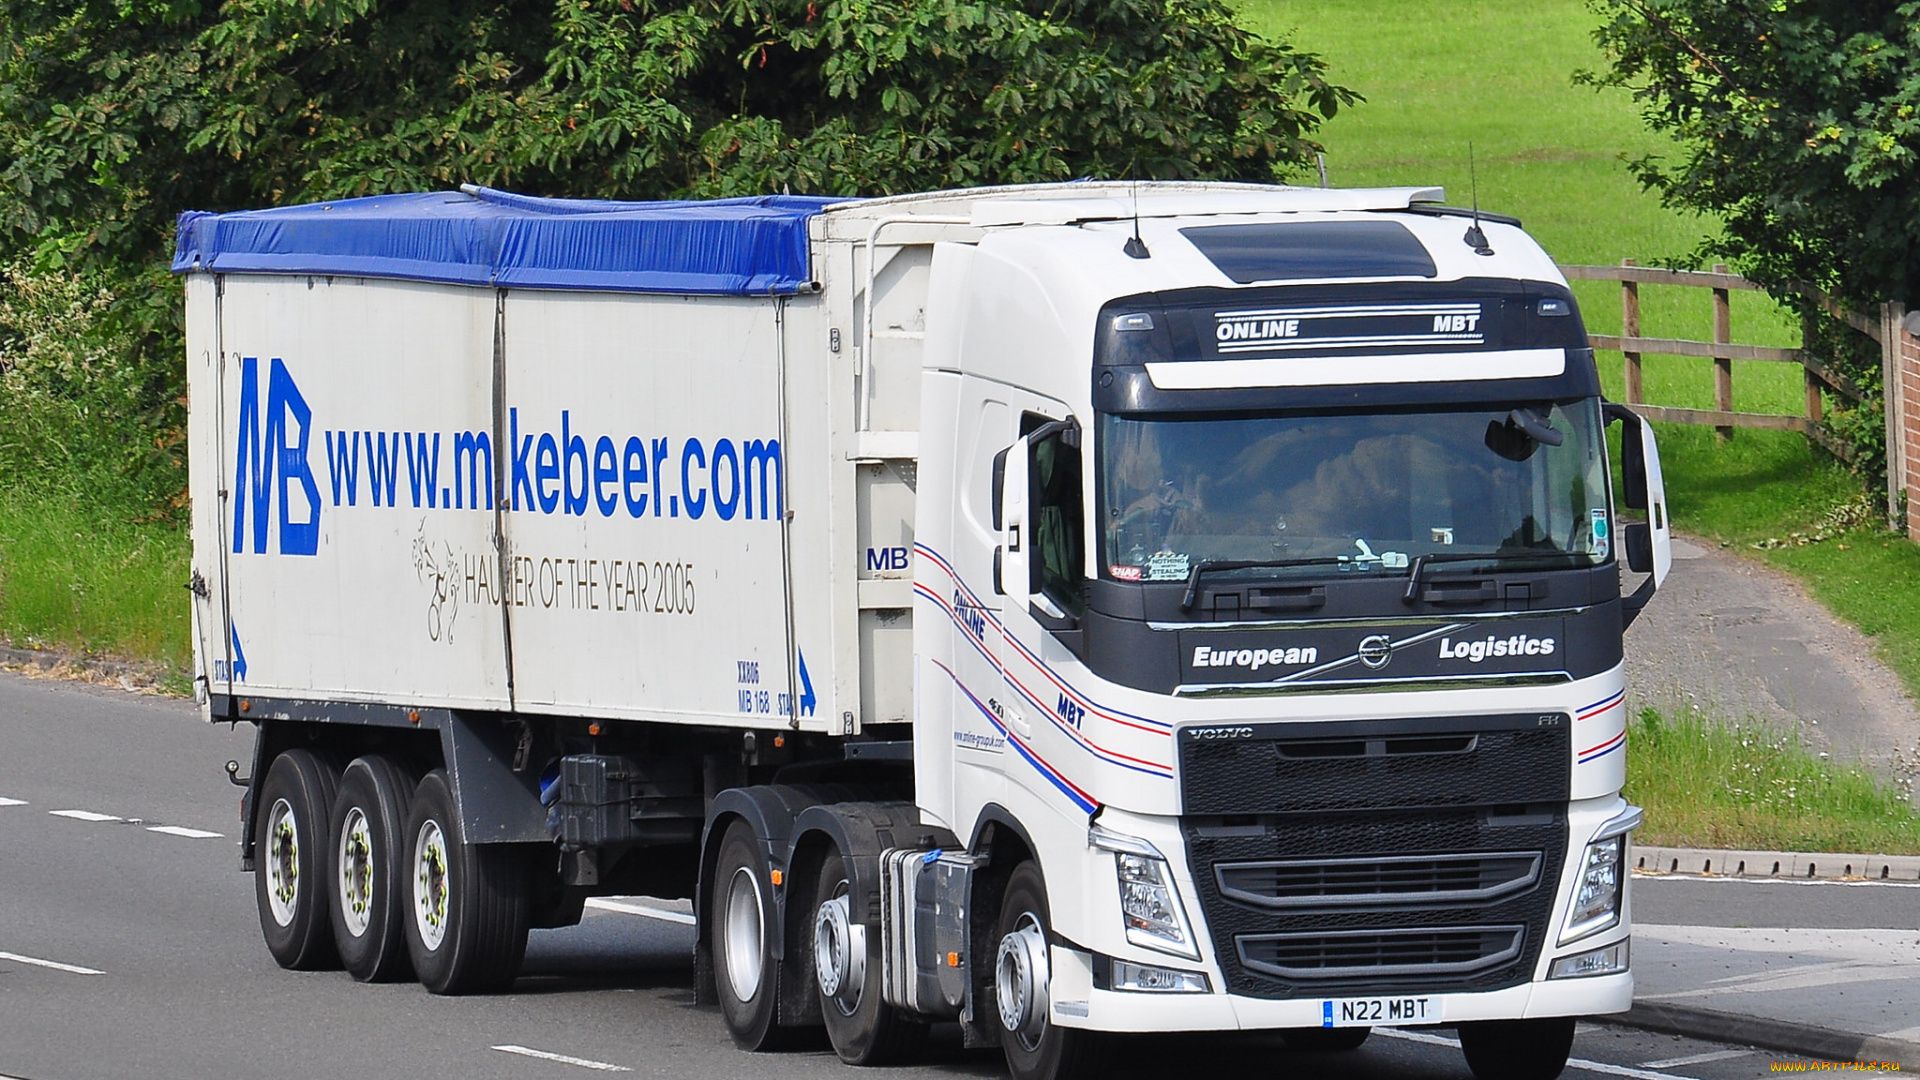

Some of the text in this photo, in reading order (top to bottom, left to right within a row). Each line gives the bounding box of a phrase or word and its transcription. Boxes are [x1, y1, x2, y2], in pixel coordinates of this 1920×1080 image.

[1216, 315, 1480, 341] ONLINE MBT
[325, 407, 783, 521] www.mkebeer.com
[867, 547, 909, 570] MB
[465, 553, 696, 614] HAUIER OF THE YEAR 2005
[953, 588, 985, 642] ONLINE
[1192, 635, 1555, 670] European Logistics
[738, 689, 770, 714] MB 168
[1057, 692, 1085, 730] MBT
[1188, 727, 1253, 740] VOLVO
[1538, 715, 1559, 726] FH
[1342, 998, 1428, 1021] N22 MBT
